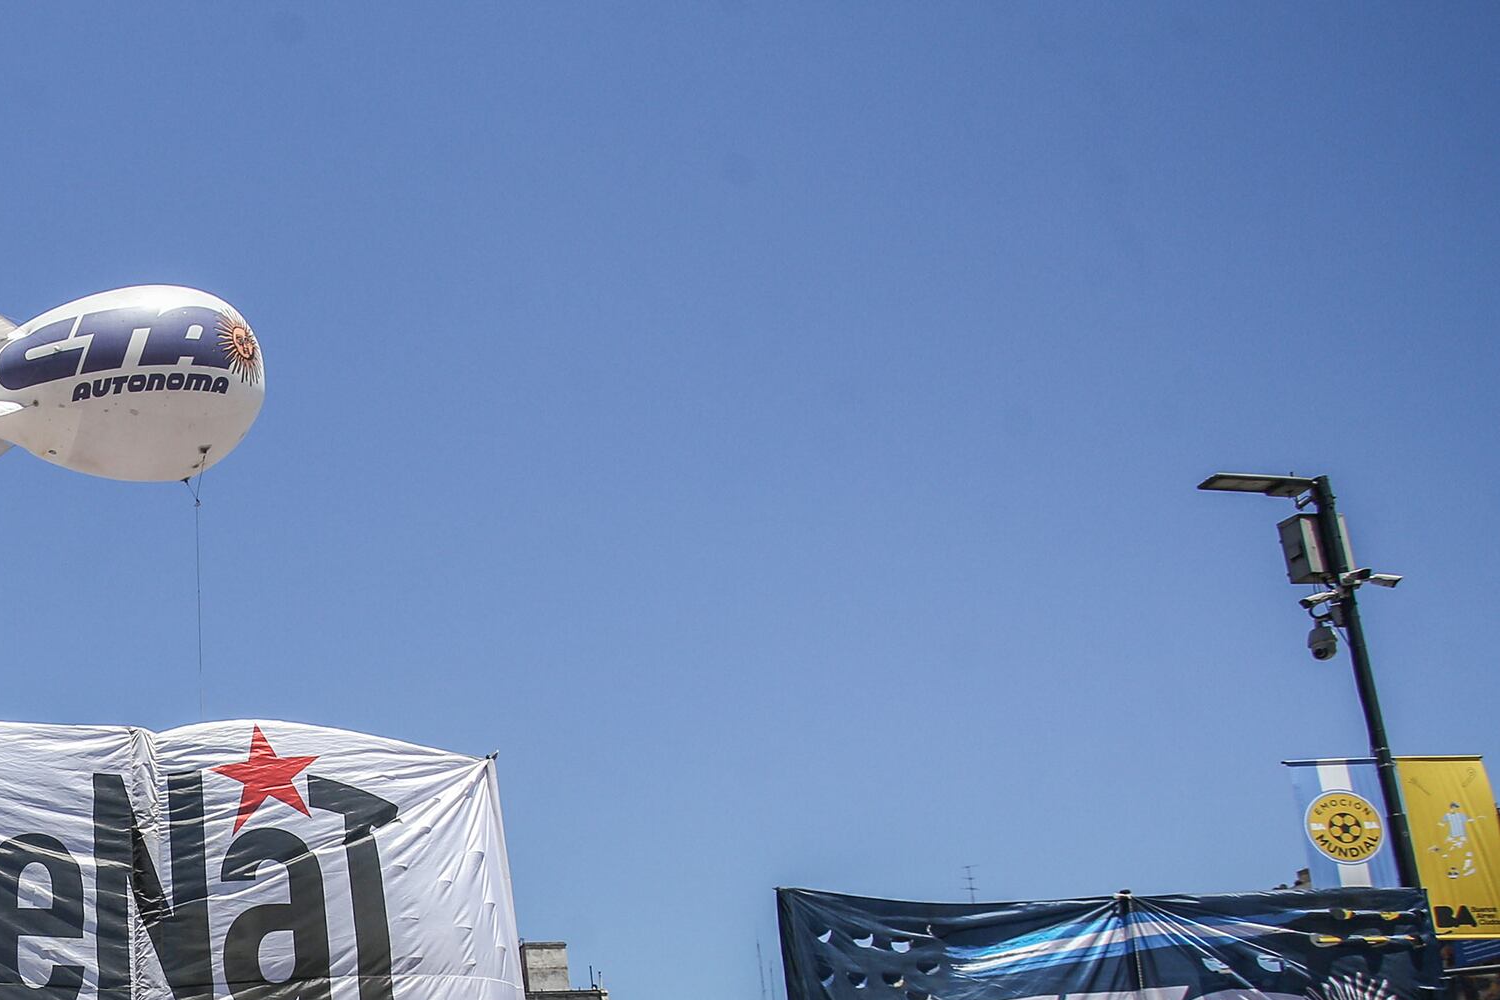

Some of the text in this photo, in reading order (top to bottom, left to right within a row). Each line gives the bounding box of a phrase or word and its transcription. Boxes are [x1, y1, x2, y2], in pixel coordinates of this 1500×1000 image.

[71, 372, 229, 401] AUTONOMA
[1315, 834, 1379, 857] MUNDIAL
[1433, 905, 1477, 928] BA
